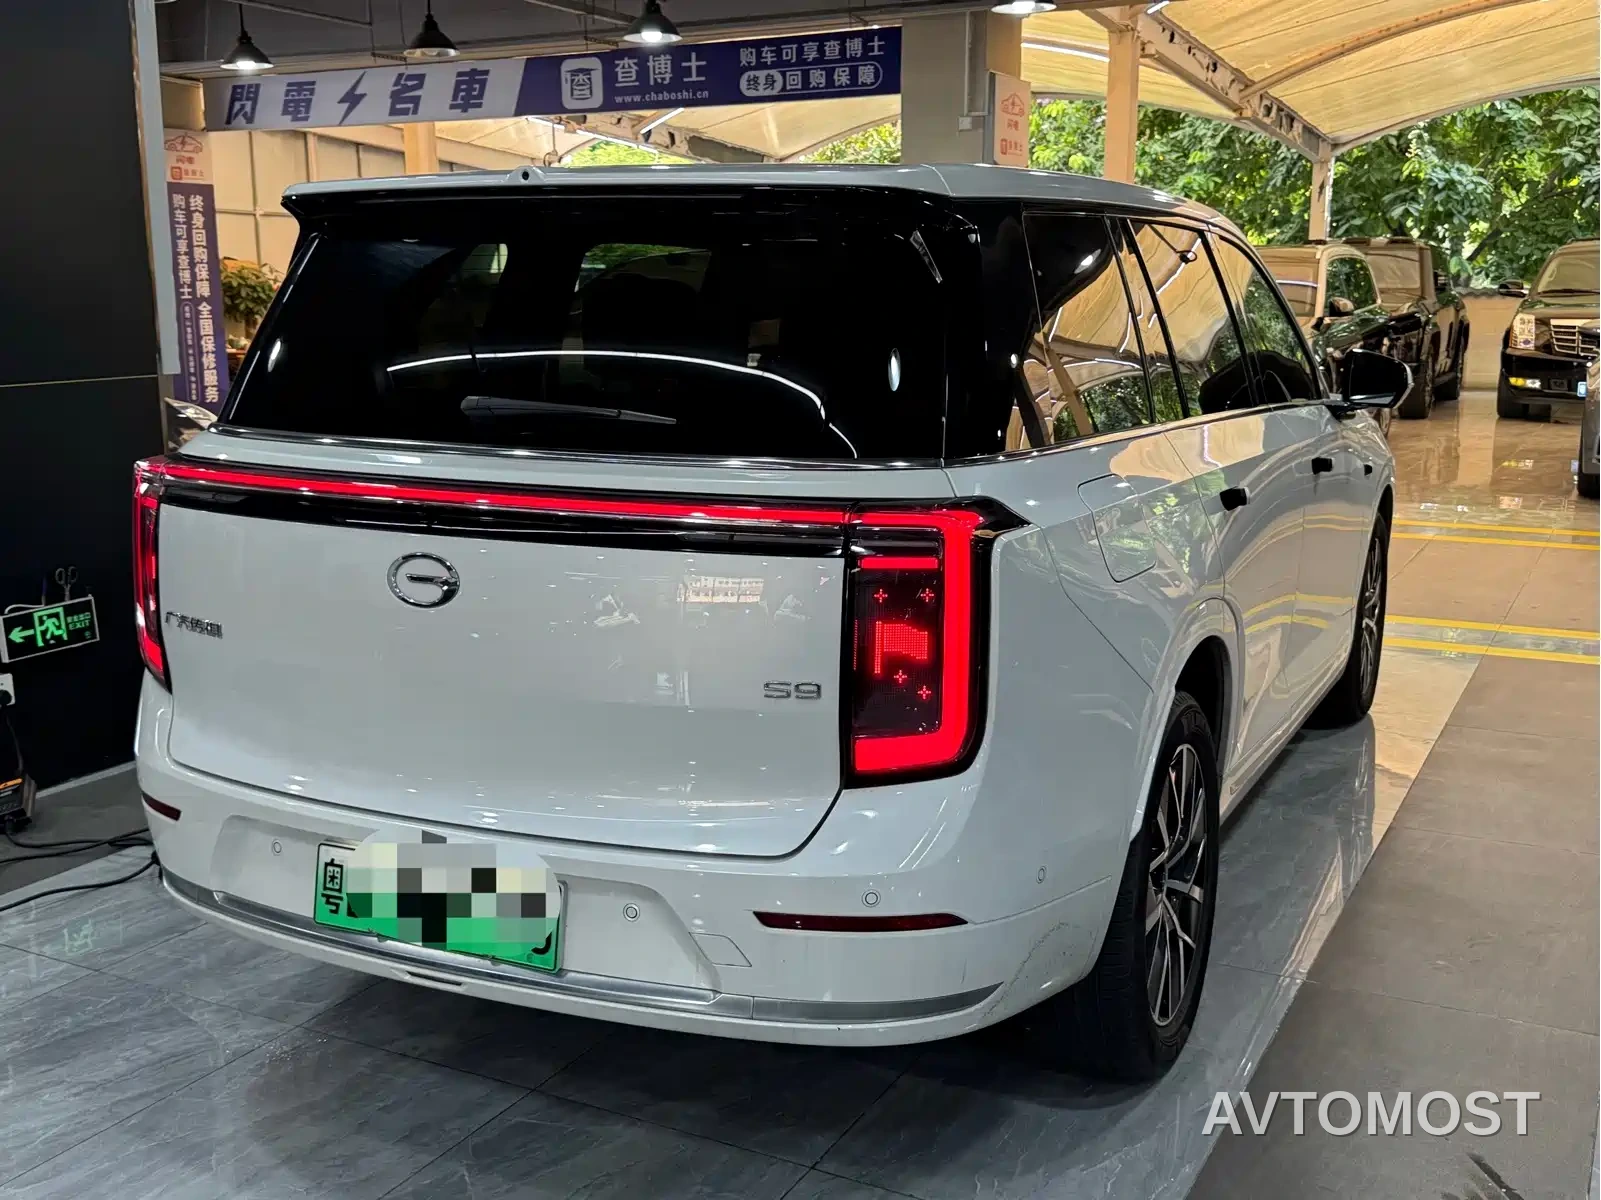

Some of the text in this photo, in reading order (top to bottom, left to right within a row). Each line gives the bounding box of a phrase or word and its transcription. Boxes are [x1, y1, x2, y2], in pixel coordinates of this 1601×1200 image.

[739, 35, 886, 67] 购车可享查博士
[614, 52, 708, 87] 查博士
[745, 65, 876, 92] 终身回购保障
[225, 68, 490, 126] 閃電 名車
[614, 89, 709, 103] www.chaboshi.cn
[172, 193, 193, 299] 购车可享查博士
[197, 301, 220, 403] 全国保修服务
[68, 619, 91, 631] EXIT
[763, 681, 822, 700] S9
